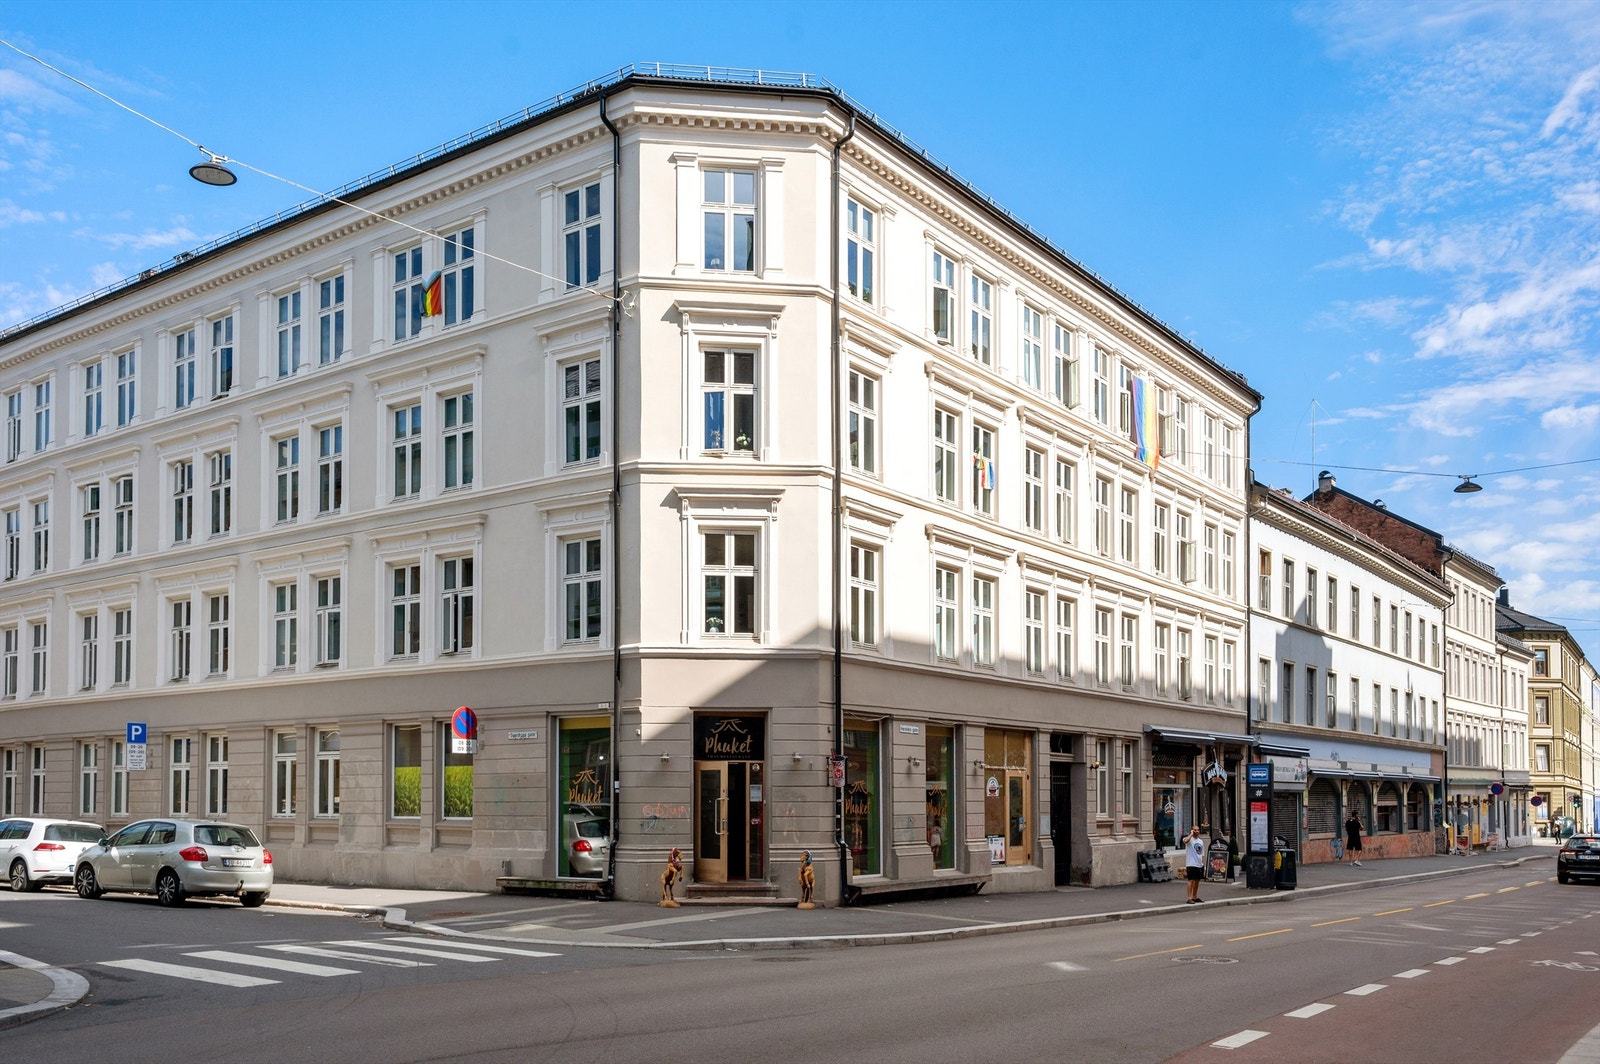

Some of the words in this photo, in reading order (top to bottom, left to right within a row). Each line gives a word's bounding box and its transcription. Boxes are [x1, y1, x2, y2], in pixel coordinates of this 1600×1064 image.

[131, 725, 142, 741] P
[705, 733, 753, 753] Phuket
[568, 784, 603, 804] Phuket
[845, 795, 872, 815] Phuket
